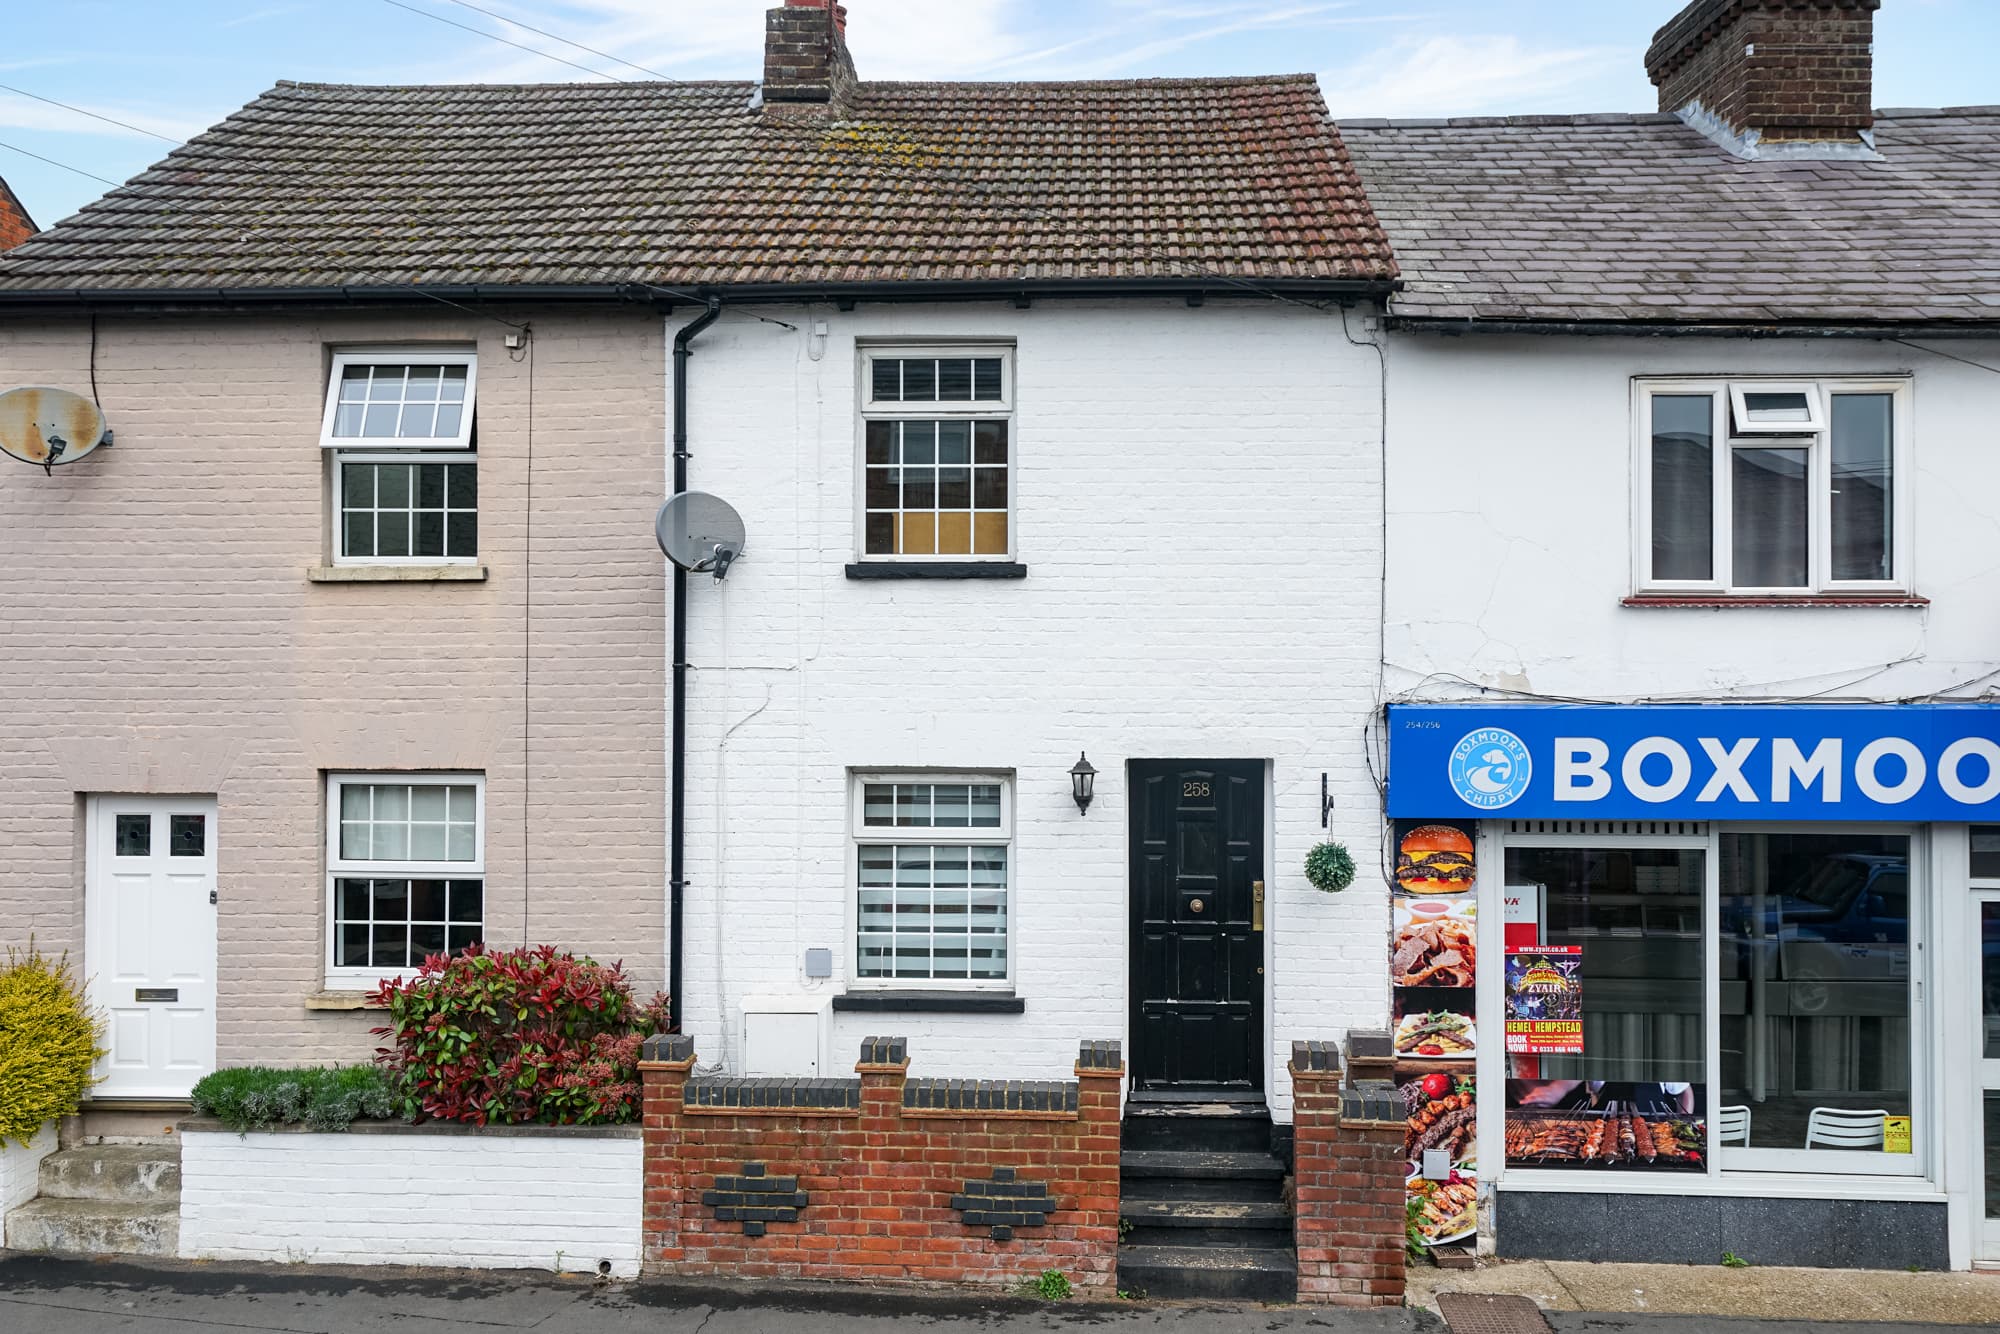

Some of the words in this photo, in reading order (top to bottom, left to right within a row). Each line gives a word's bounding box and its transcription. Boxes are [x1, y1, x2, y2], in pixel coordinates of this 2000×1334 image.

[1405, 720, 1441, 729] 254/256
[1455, 731, 1526, 761] BOXMOOR'S
[1553, 736, 2000, 804] BOXMOO
[1183, 782, 1210, 797] 258
[1464, 788, 1514, 806] CHIPPY
[1528, 984, 1561, 993] ZYAIR
[1507, 1021, 1533, 1033] HEMEL
[1535, 1021, 1581, 1033] HEMPSTEAD
[1507, 1034, 1528, 1044] BOOK
[1507, 1043, 1528, 1053] NOW!
